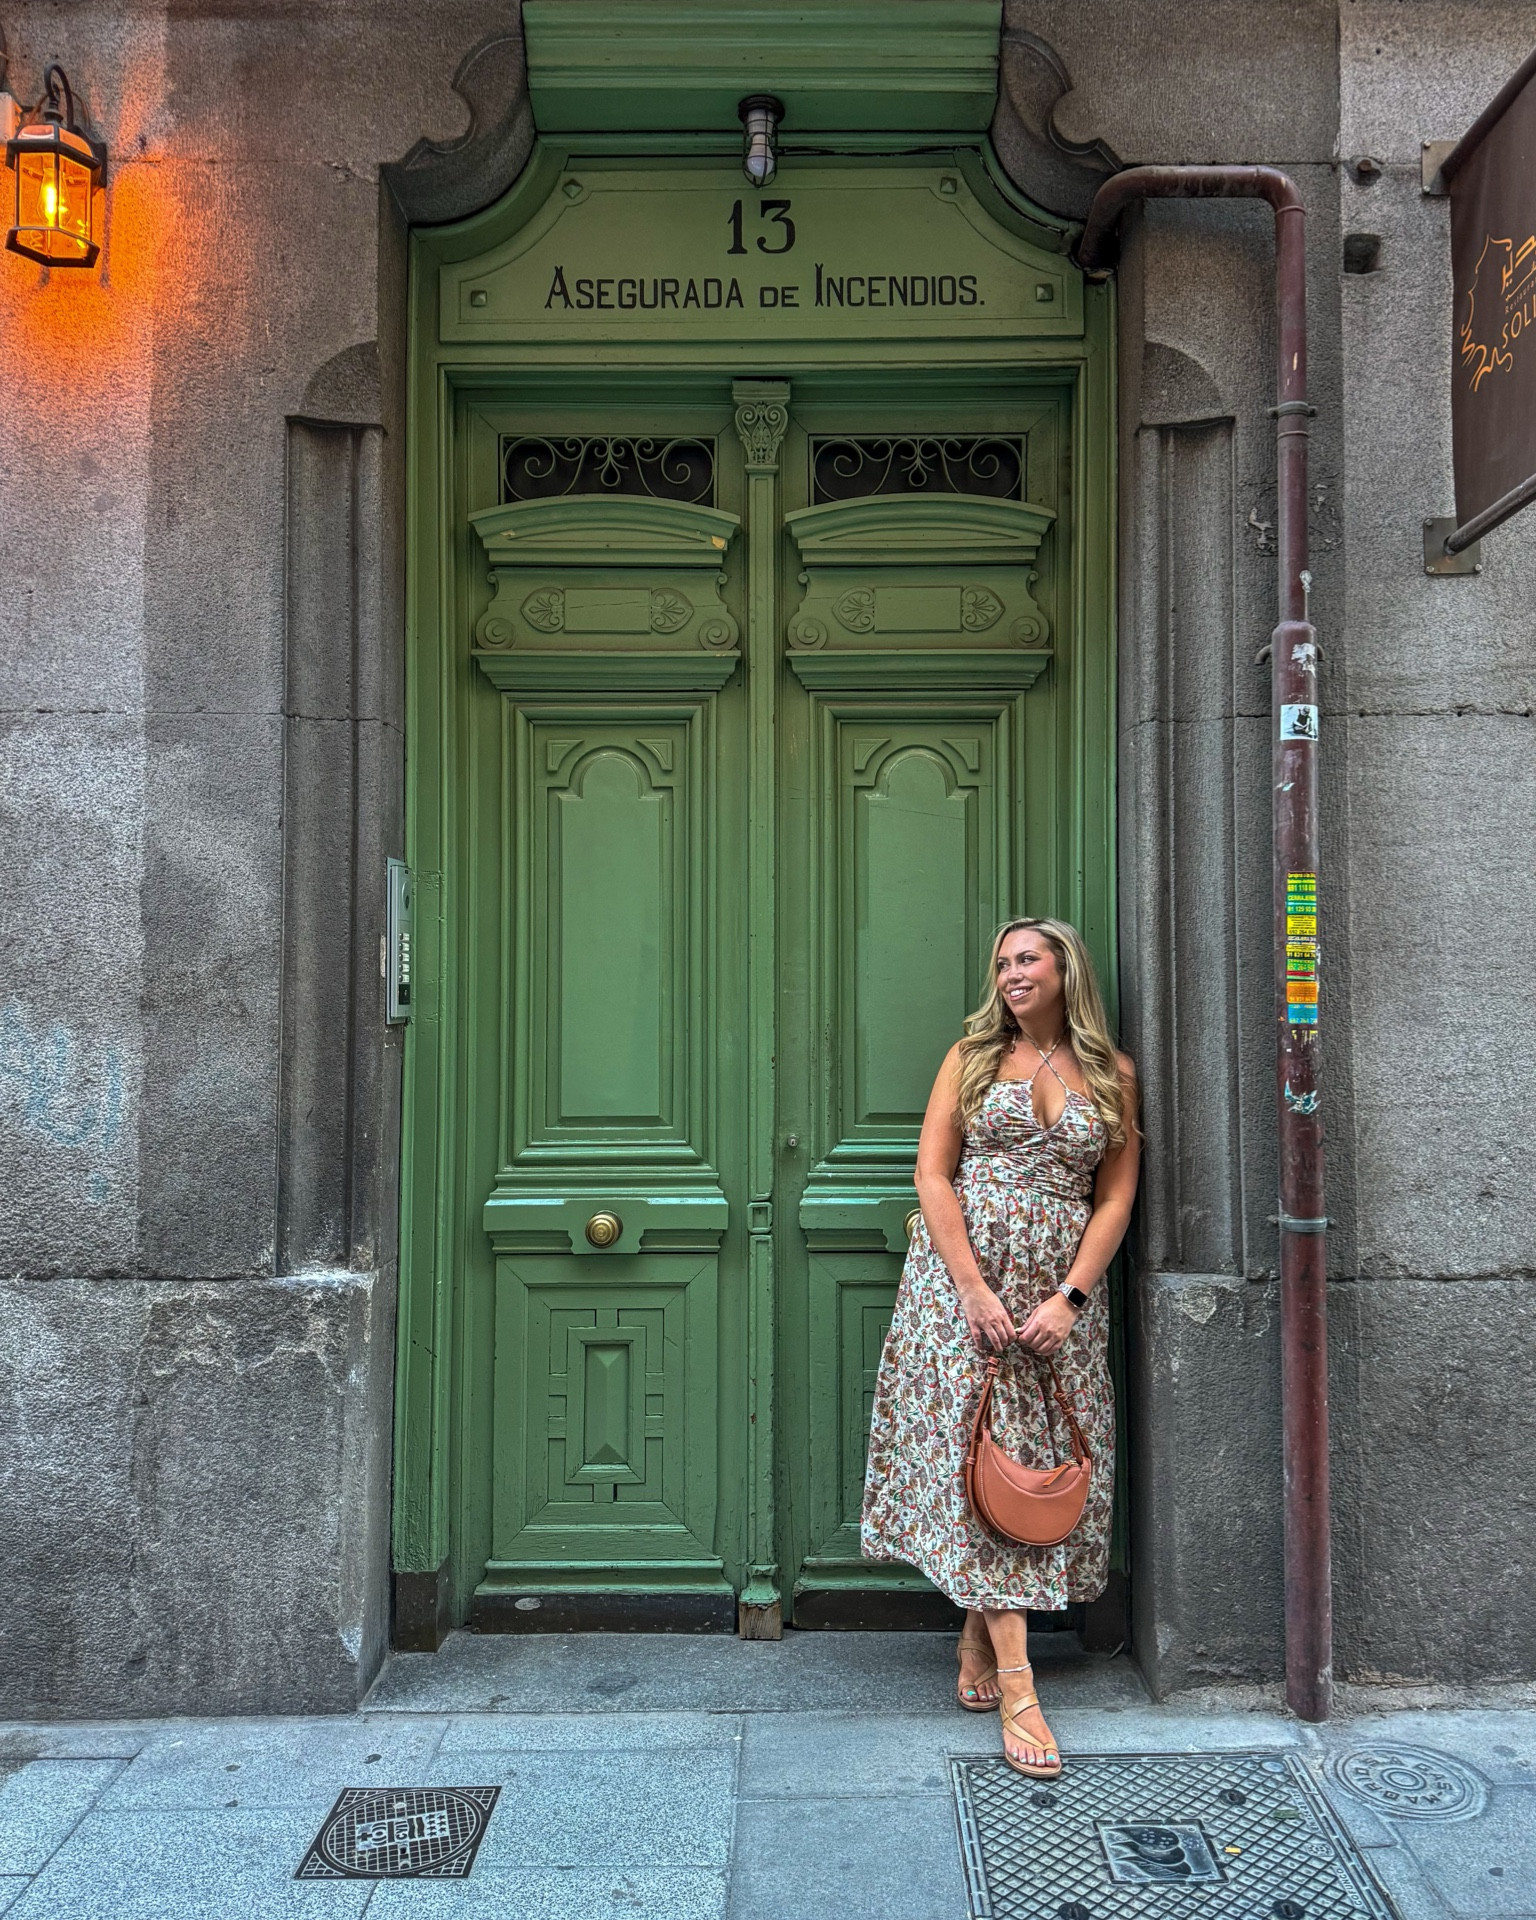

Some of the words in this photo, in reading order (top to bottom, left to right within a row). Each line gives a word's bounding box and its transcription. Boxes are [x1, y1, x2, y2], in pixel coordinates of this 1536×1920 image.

[727, 200, 796, 255] 13
[544, 266, 744, 310] ASEGURADA
[759, 286, 800, 309] DE
[814, 263, 985, 308] INCENDIOS.
[1505, 277, 1536, 315] Restaura
